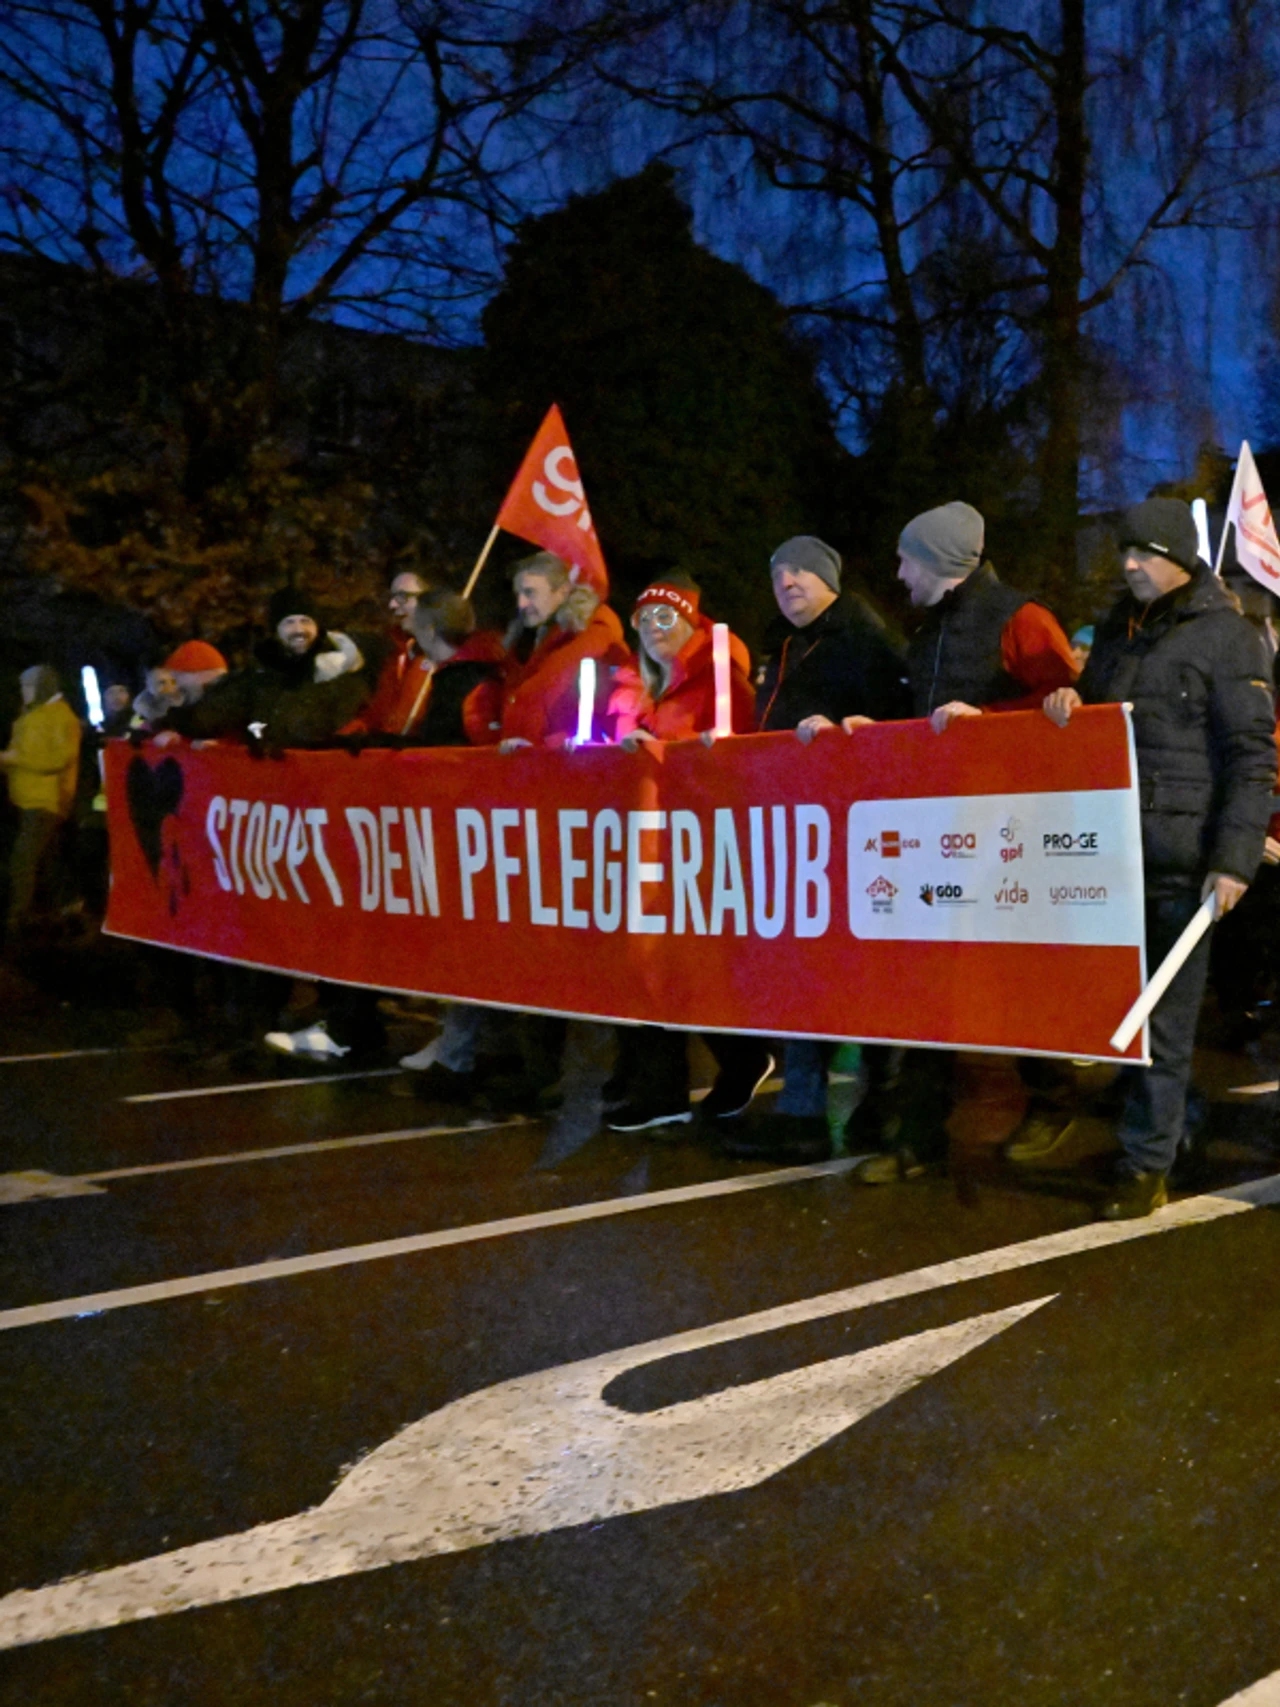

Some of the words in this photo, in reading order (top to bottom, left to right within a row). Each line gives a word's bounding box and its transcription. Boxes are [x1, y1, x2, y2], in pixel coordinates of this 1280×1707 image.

[1043, 832, 1098, 850] PRO-GE
[206, 796, 344, 907] STOPPT
[345, 806, 441, 918] DEN
[455, 803, 831, 939] PFLEGERAUB
[994, 877, 1028, 904] vida
[1049, 886, 1107, 905] younion
